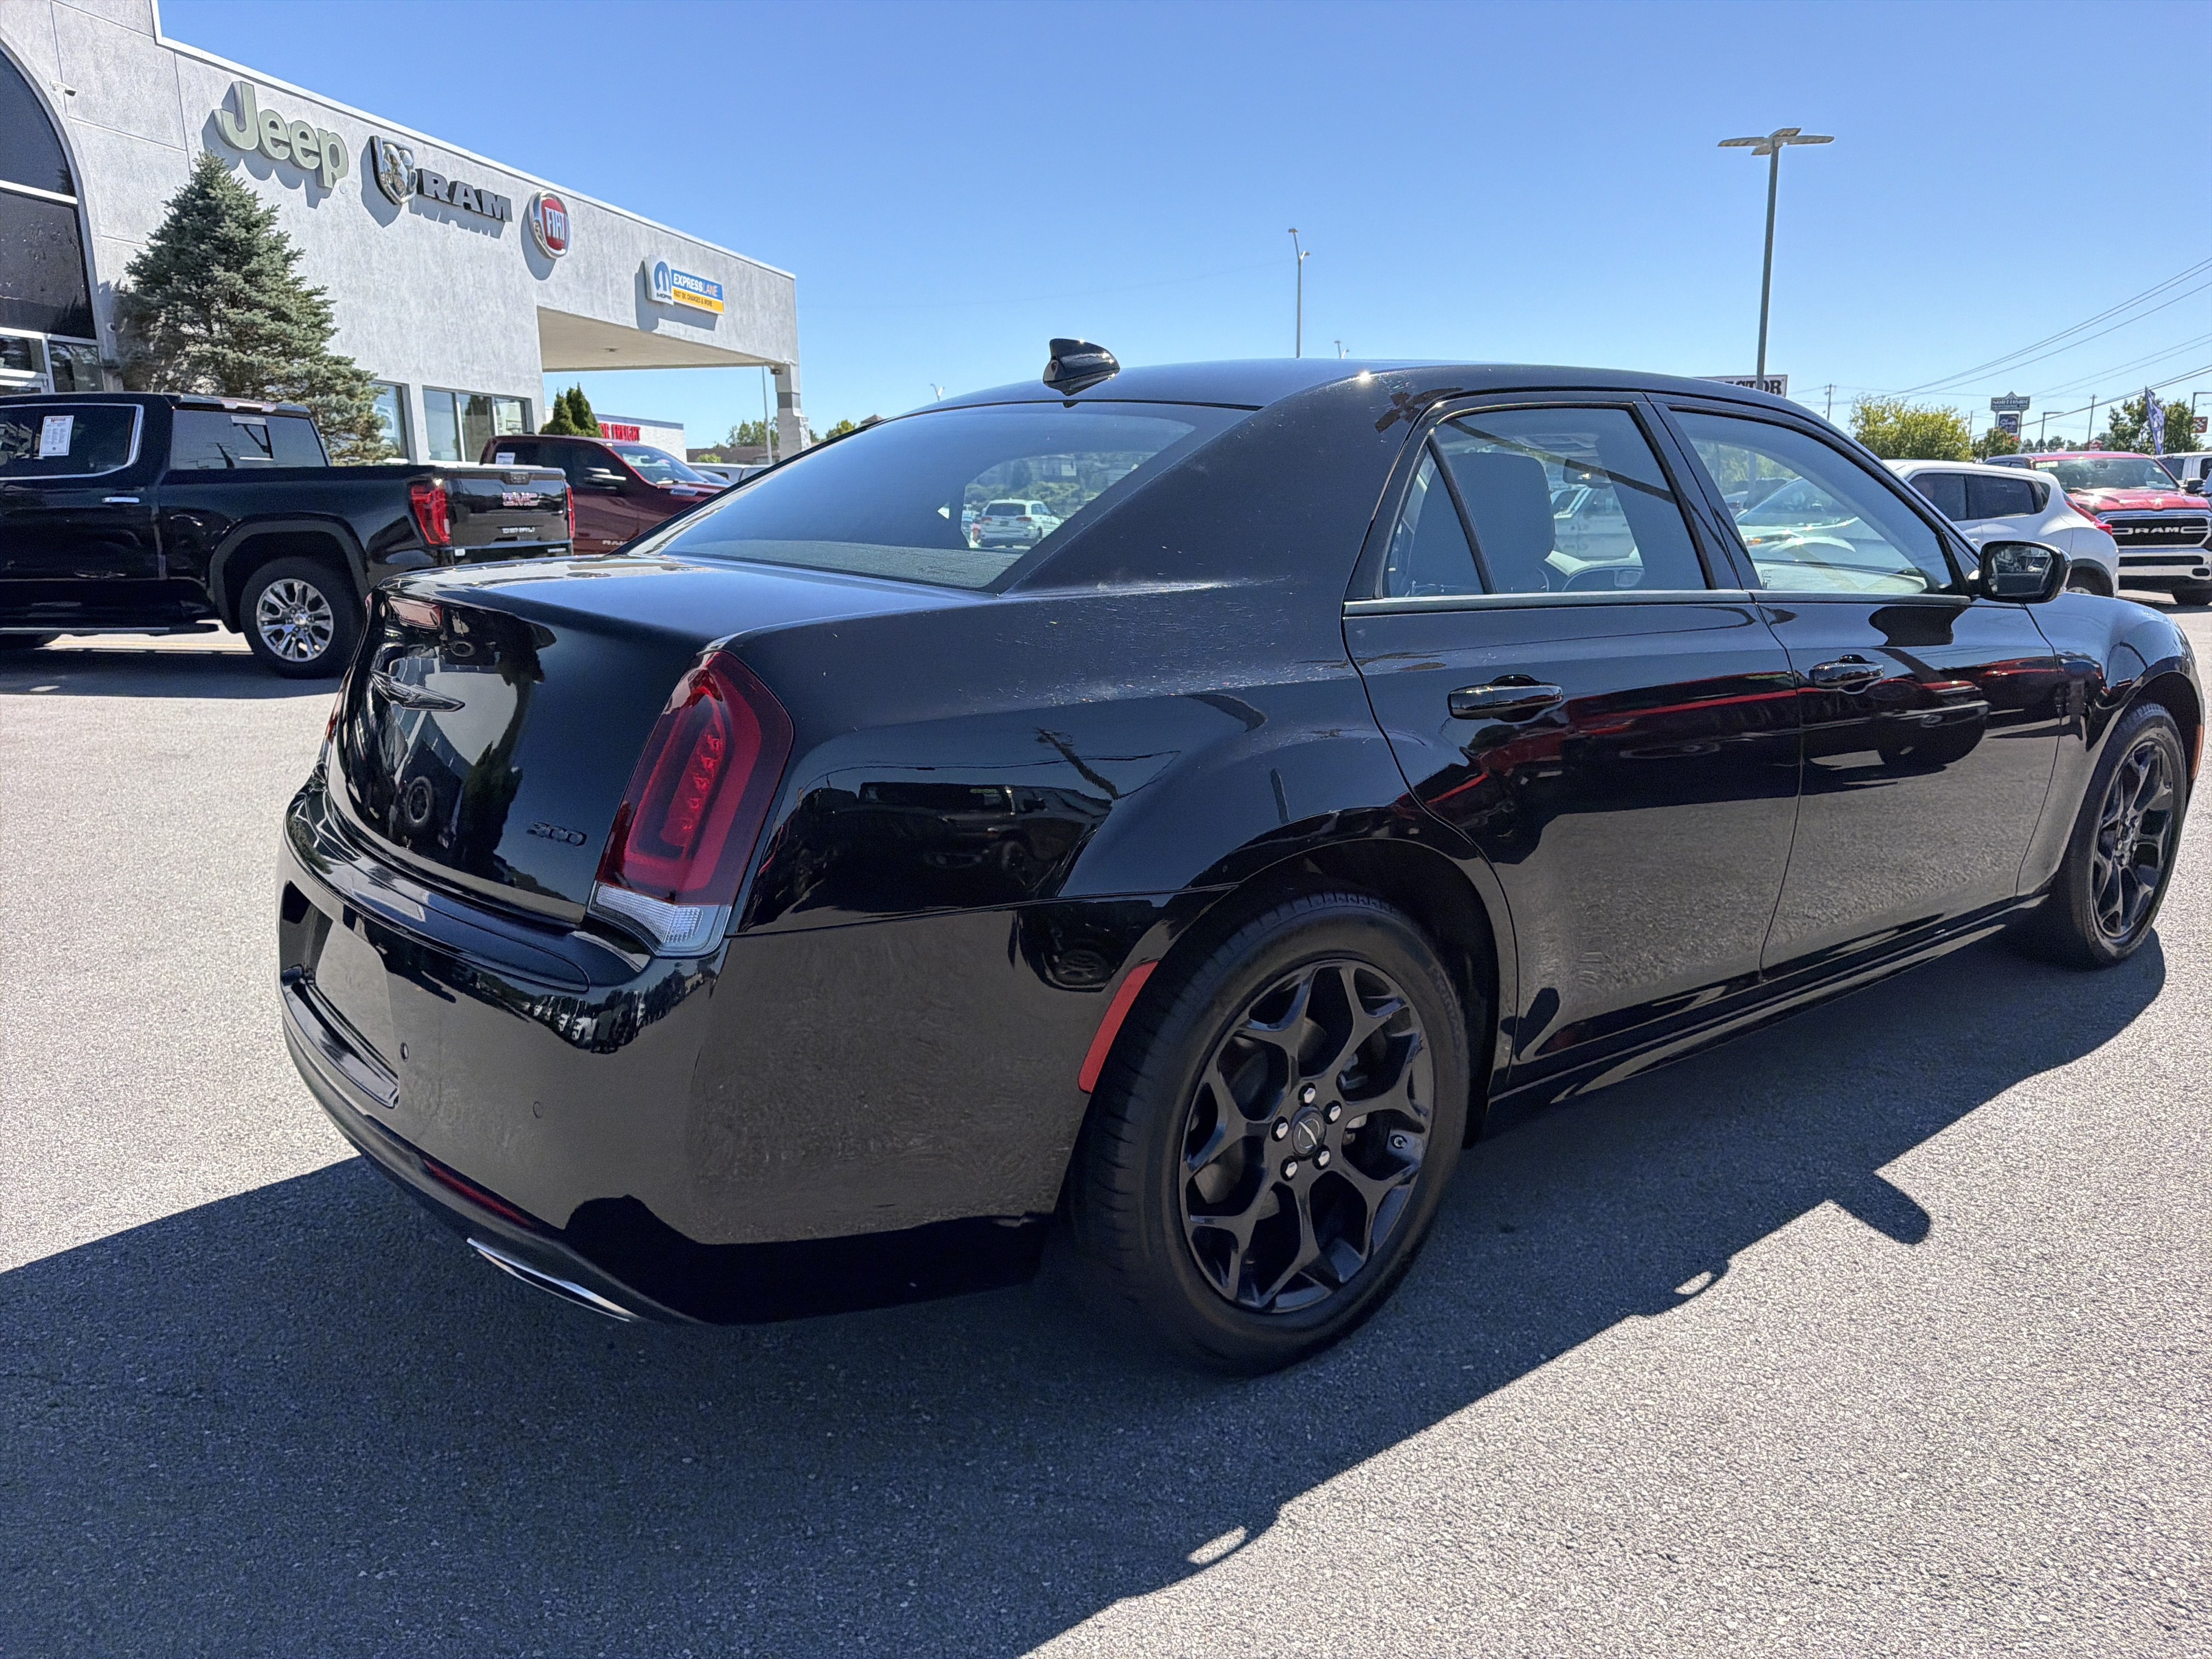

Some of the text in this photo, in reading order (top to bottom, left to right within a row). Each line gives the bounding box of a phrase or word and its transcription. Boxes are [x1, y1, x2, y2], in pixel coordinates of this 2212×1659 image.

[213, 81, 349, 188] Jeep
[416, 168, 512, 222] RAM
[545, 207, 565, 241] FIAT
[612, 424, 641, 441] FREIGHT
[502, 492, 539, 506] GMC
[526, 822, 587, 847] 300
